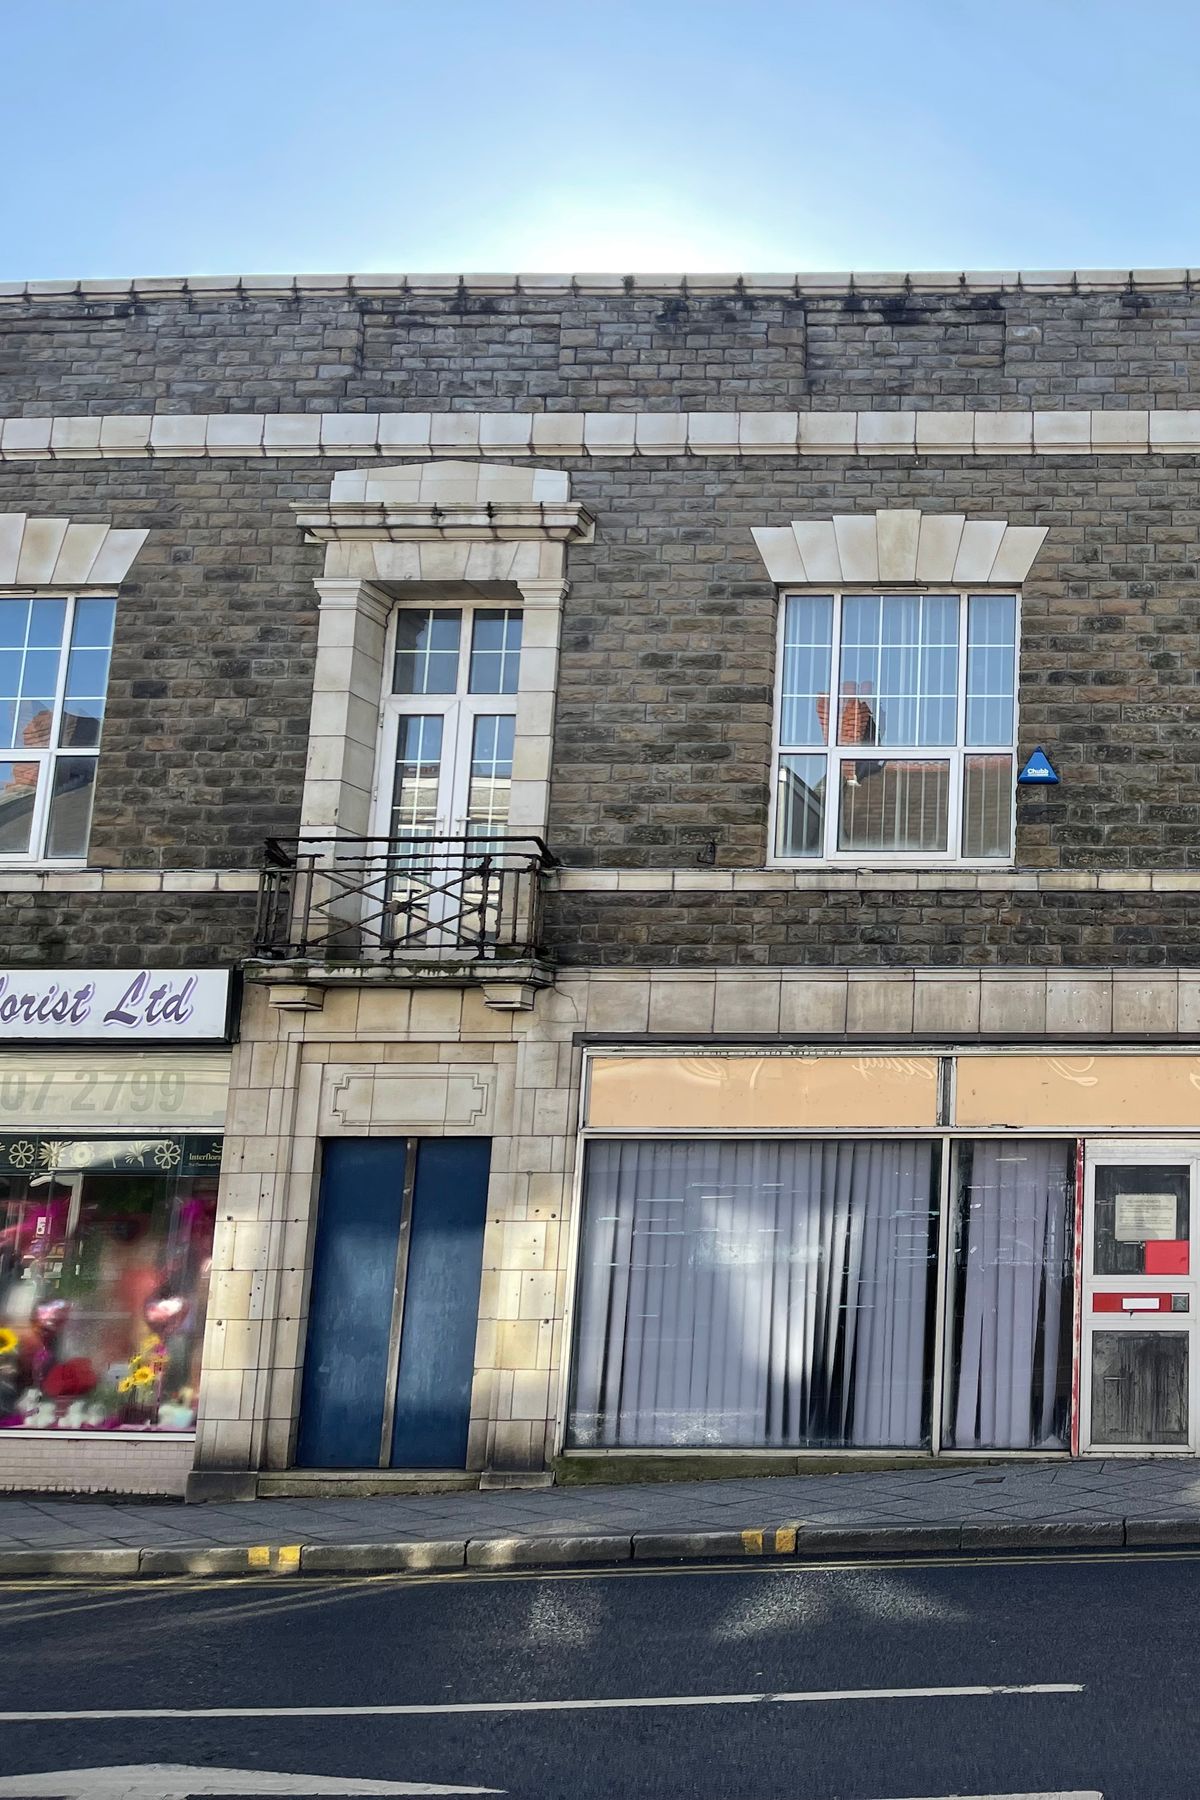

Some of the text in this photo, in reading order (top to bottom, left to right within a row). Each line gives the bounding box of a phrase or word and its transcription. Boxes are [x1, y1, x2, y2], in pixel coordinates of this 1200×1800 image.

[103, 970, 197, 1027] Ltd
[70, 1066, 186, 1112] 2799
[189, 1152, 222, 1161] Interflora
